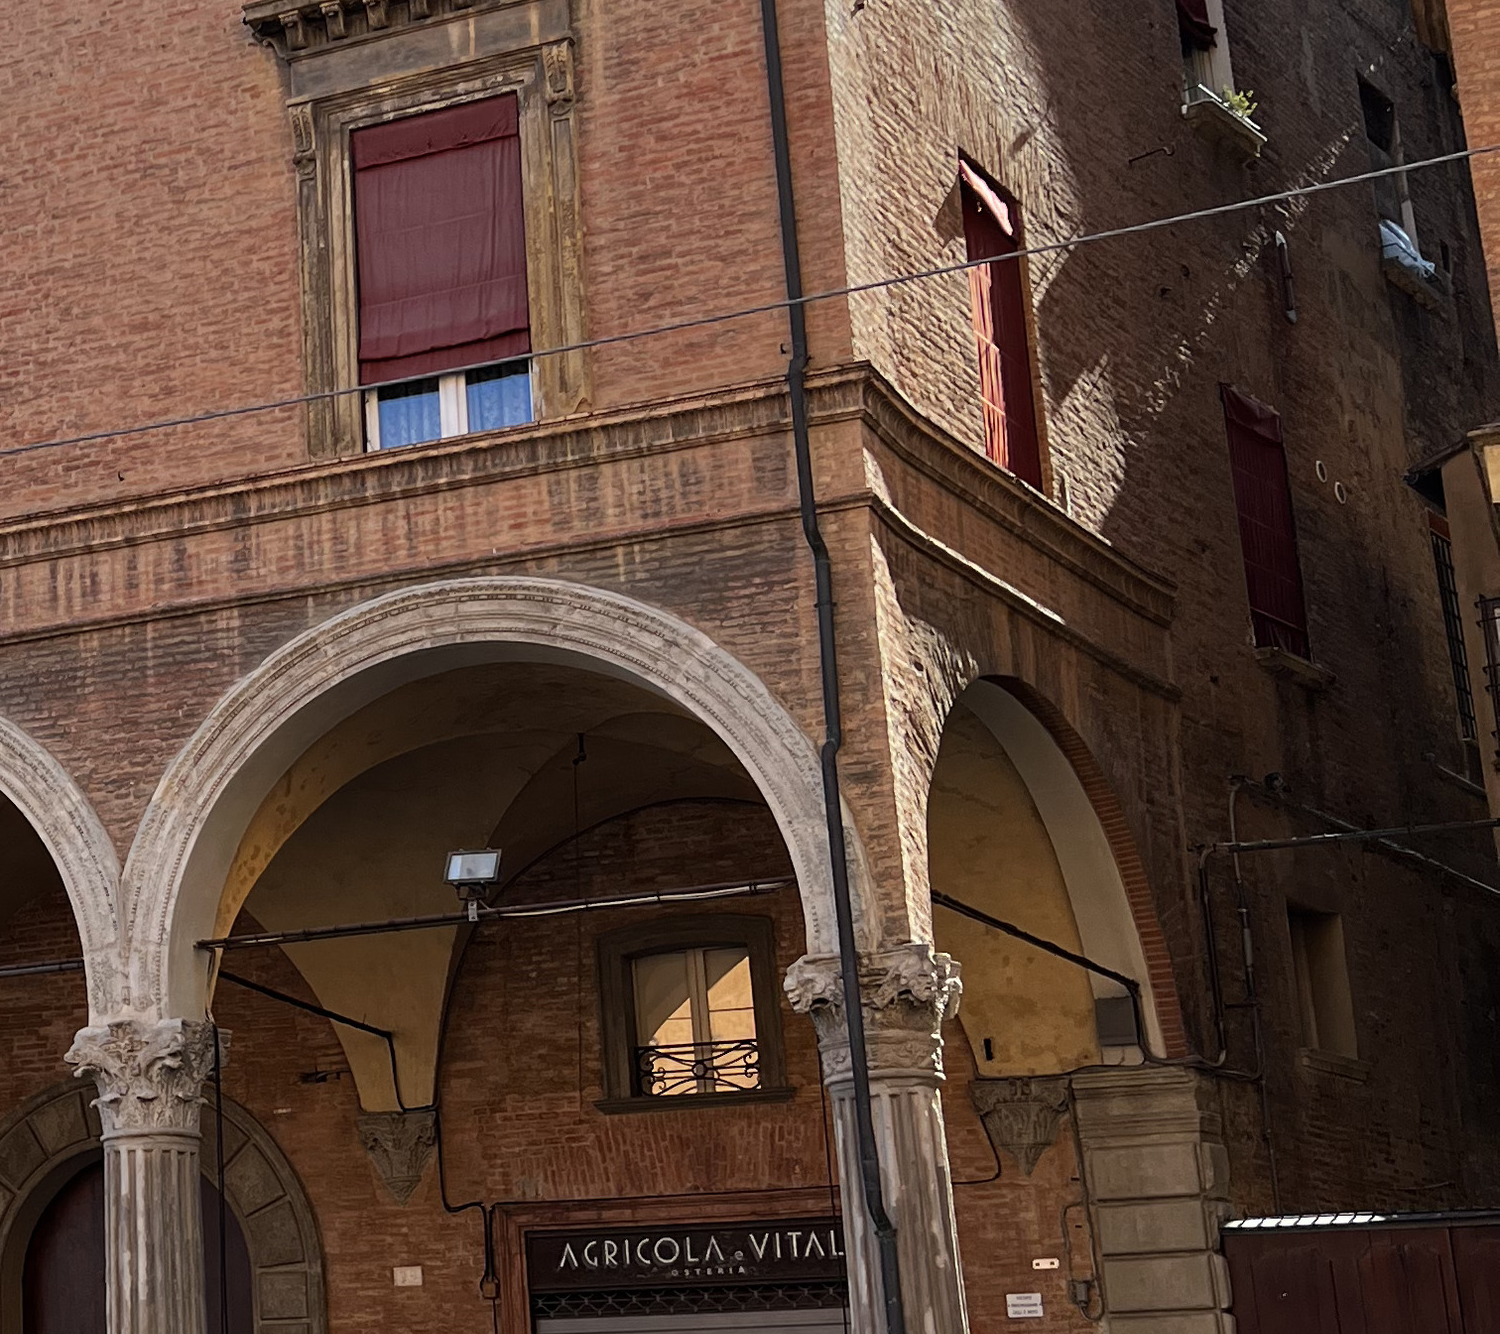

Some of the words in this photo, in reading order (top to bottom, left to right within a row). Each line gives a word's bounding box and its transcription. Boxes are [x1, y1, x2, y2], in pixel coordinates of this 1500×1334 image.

[560, 1236, 725, 1268] AGRICOLA
[749, 1229, 845, 1260] VITAL
[670, 1265, 746, 1277] OSTERIA
